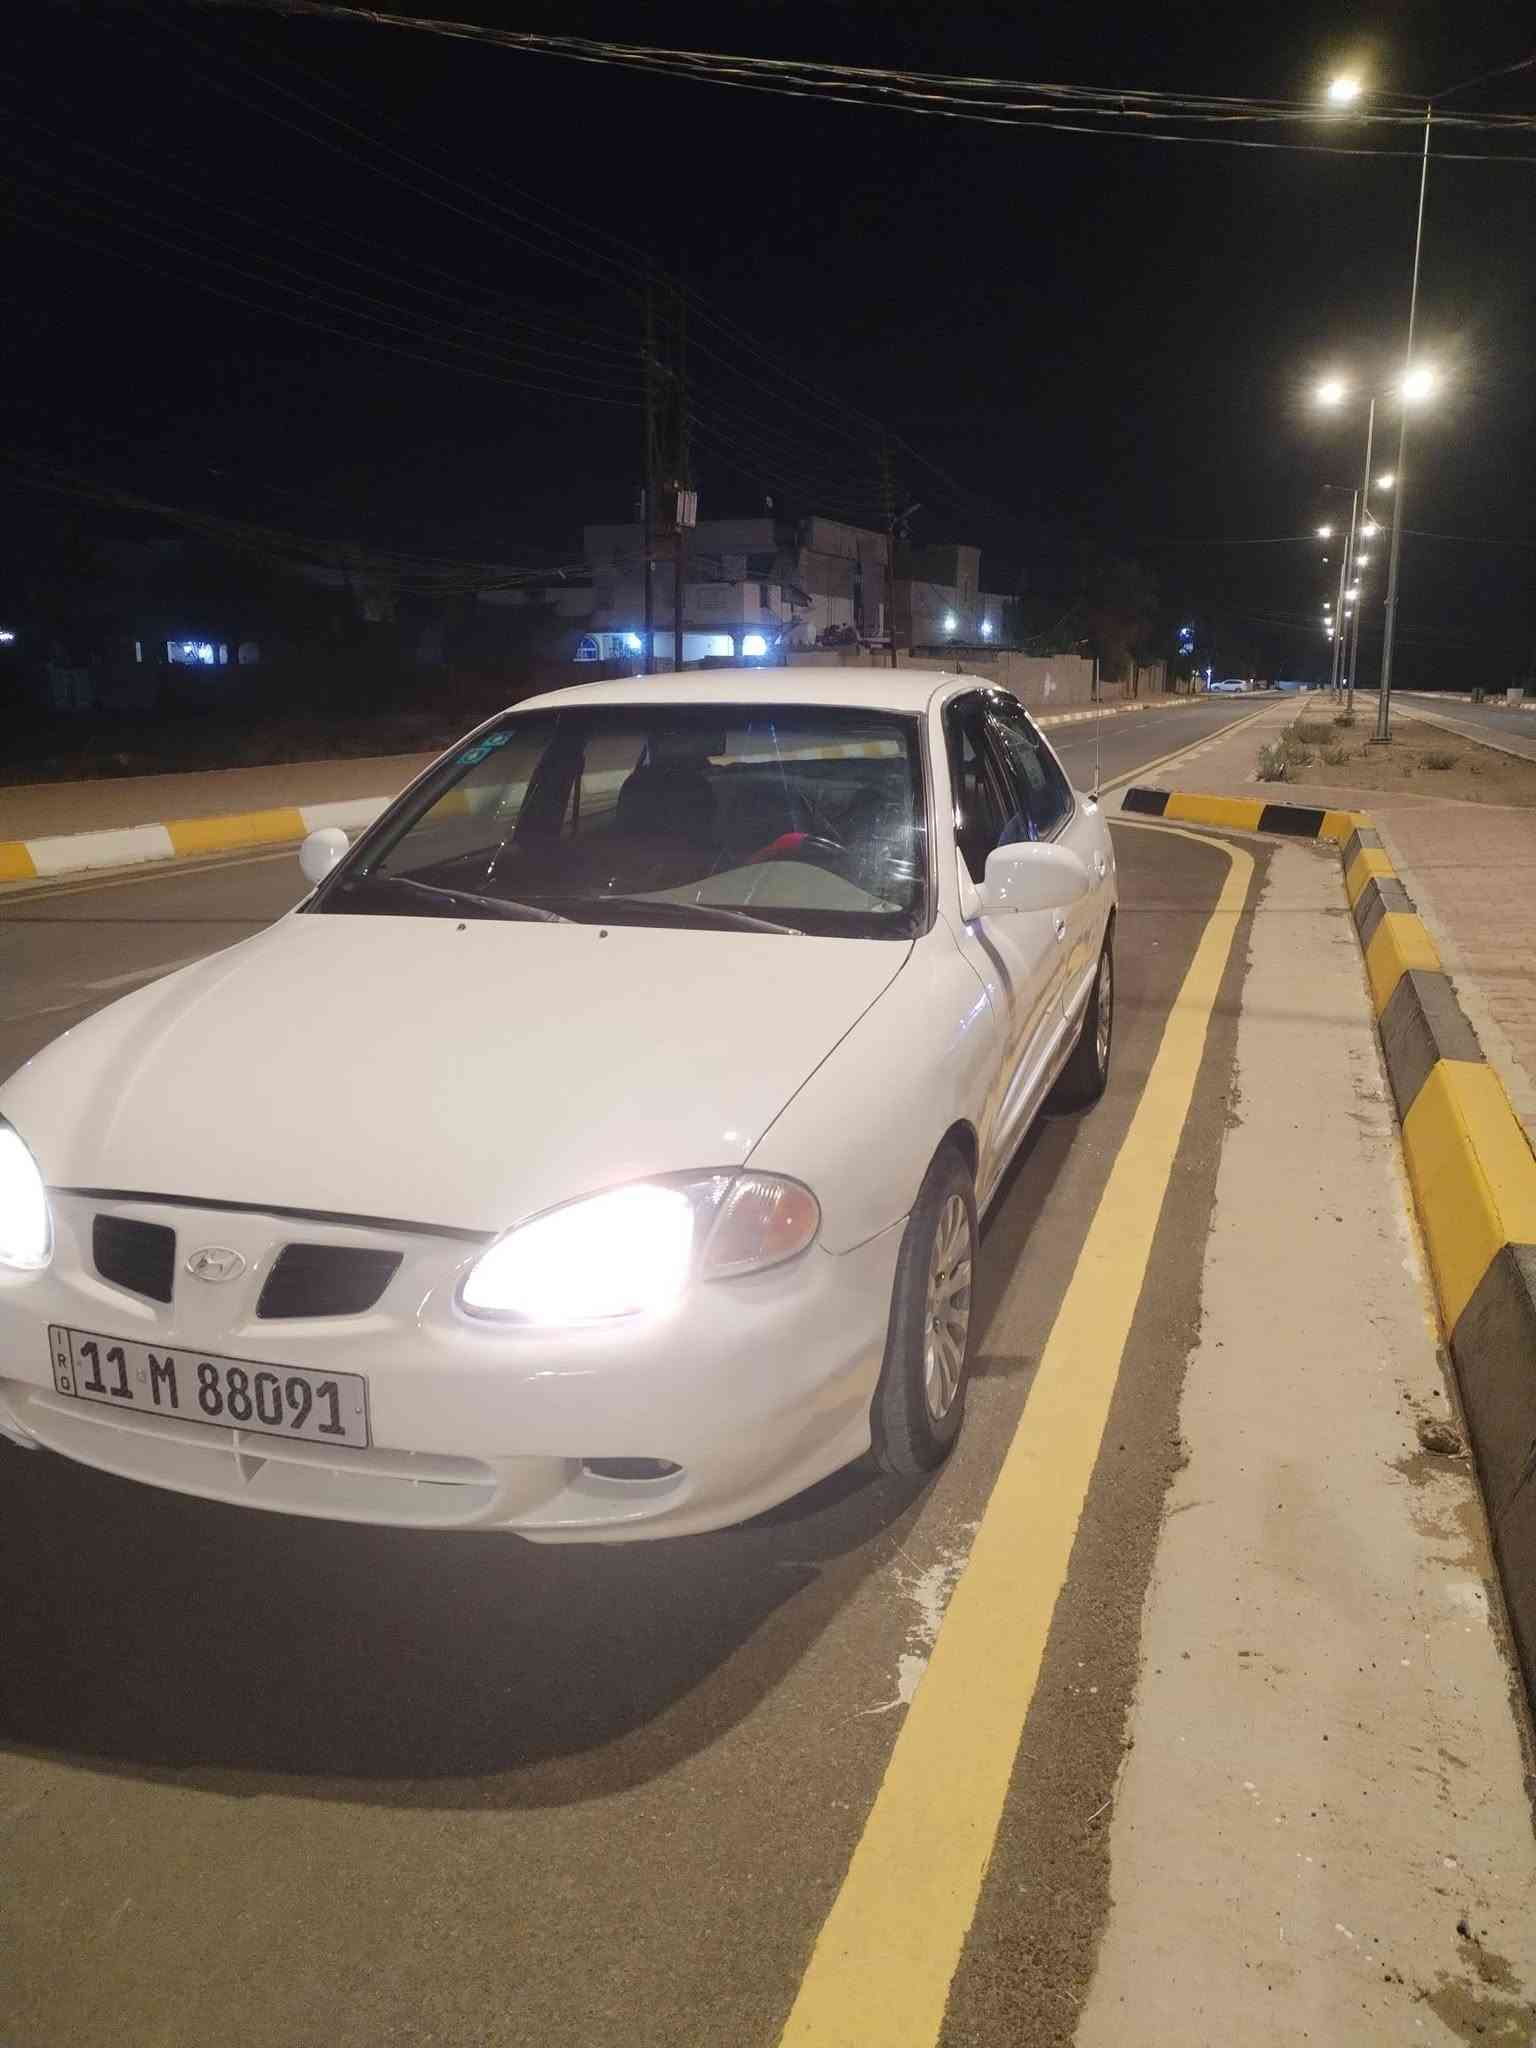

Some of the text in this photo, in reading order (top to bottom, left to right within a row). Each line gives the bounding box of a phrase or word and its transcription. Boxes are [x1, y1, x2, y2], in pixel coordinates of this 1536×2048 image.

[80, 1341, 345, 1435] 11 M 88091
